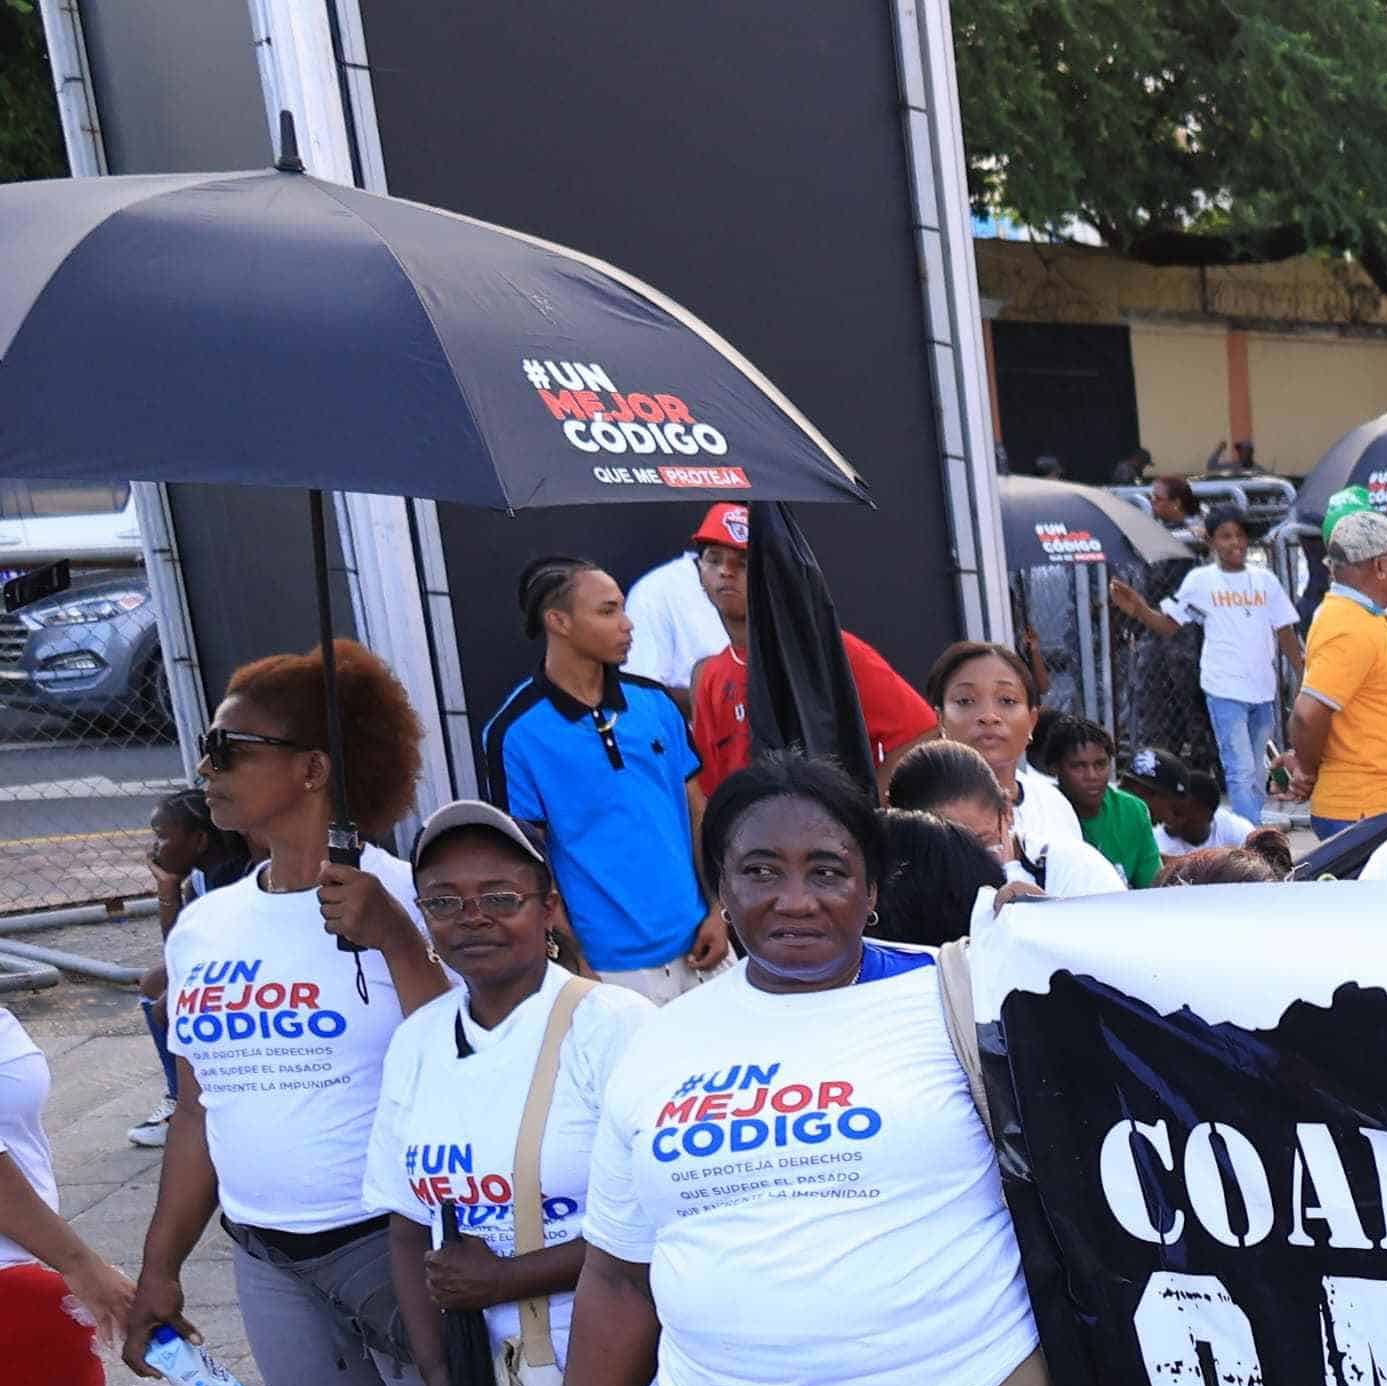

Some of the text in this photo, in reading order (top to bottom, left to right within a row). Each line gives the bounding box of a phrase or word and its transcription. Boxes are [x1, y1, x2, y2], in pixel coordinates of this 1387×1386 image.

[522, 358, 617, 393] #UN
[536, 388, 698, 425] MEJOR
[562, 411, 729, 455] CÓDIGO
[593, 466, 745, 487] QUE ME PROTEJA
[175, 982, 321, 1016] MEJOR
[671, 1062, 782, 1100] #UN
[655, 1080, 855, 1128] MEJOR
[405, 1143, 474, 1176] #UN
[671, 1151, 864, 1183] QUE PROTEJA DERECHOS
[409, 1173, 516, 1206] MEJO
[680, 1189, 709, 1201] QUE
[797, 1171, 861, 1185] PASADO
